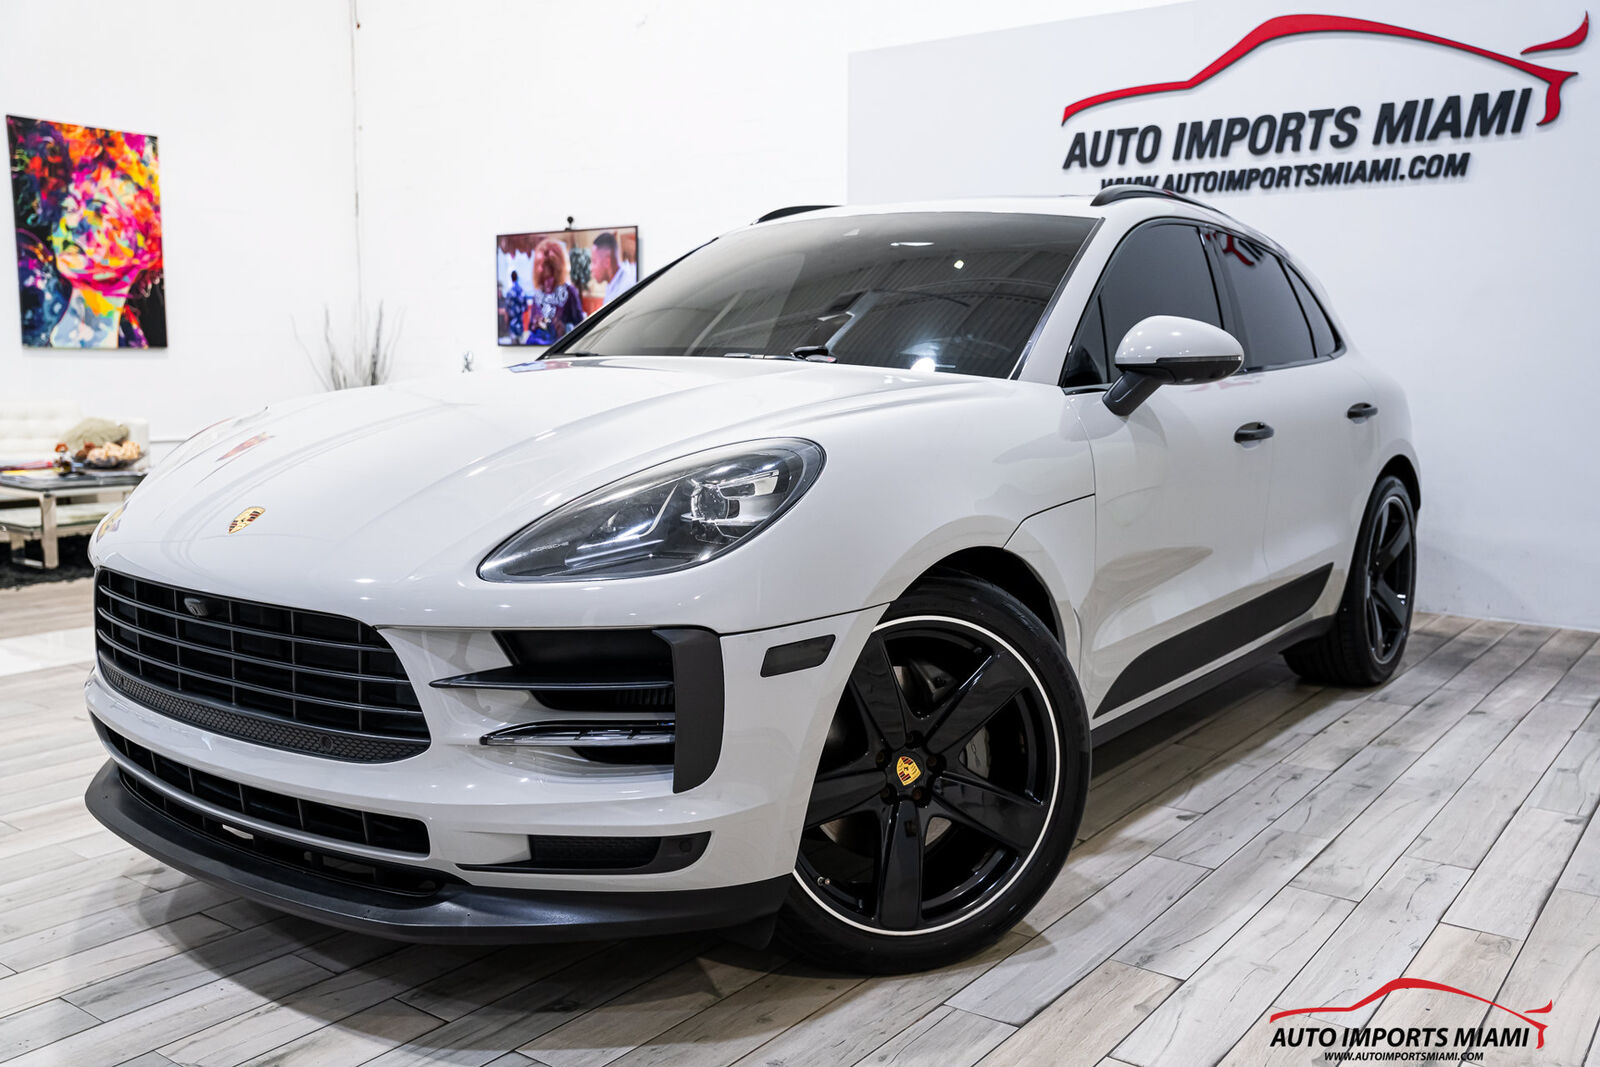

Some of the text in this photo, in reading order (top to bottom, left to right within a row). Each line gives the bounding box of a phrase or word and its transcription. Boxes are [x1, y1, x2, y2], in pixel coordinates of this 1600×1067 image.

[1062, 88, 1533, 170] AUTO IMPORTS MIAMI
[1101, 152, 1471, 194] WAUTOIMPORTSMIAMI.COM
